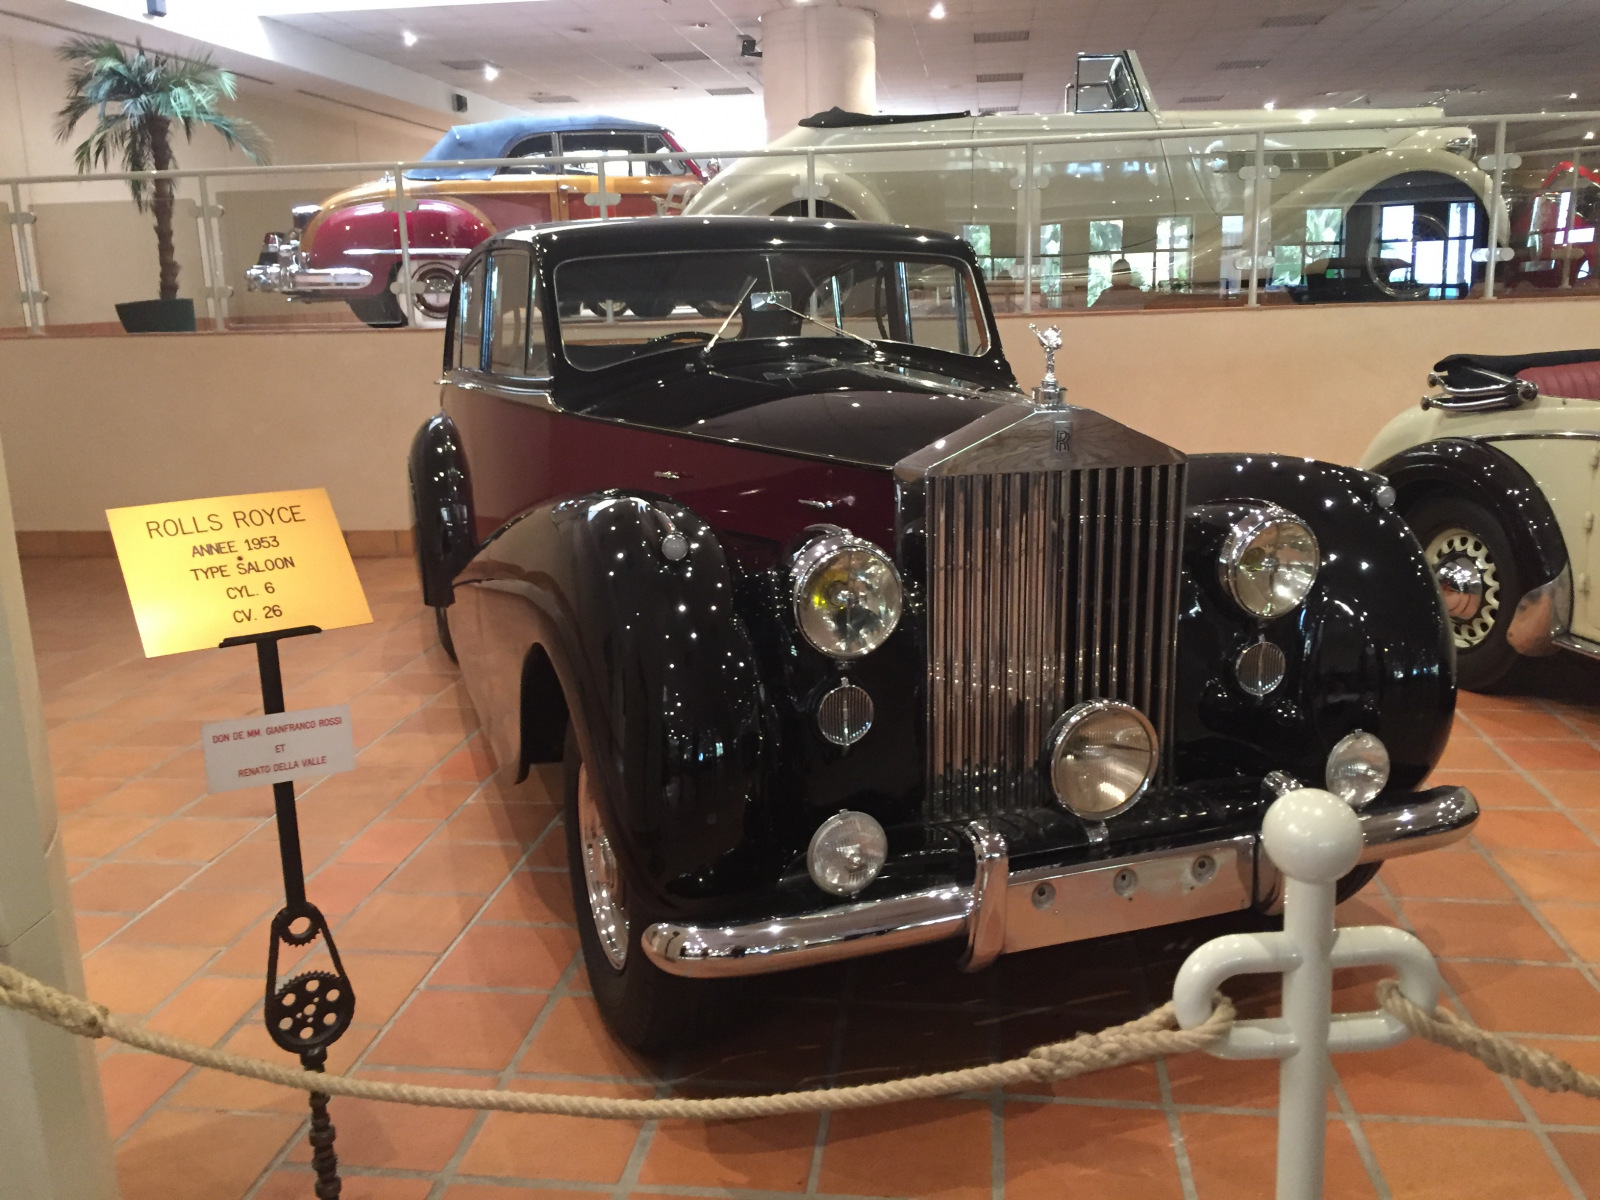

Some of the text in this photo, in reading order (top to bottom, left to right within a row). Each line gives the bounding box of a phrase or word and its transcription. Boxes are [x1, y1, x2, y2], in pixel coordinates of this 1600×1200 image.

[145, 505, 306, 539] ROLLS ROYCE
[191, 535, 280, 557] ANNEE 1953
[190, 556, 295, 581] TYPE SALOON
[226, 581, 275, 600] CYL. 6
[233, 604, 283, 623] CV. 26
[212, 733, 230, 744] DON
[233, 731, 243, 740] DE
[265, 720, 316, 736] GIANFRANCO
[318, 716, 342, 727] ROSSI
[275, 744, 285, 753] ET
[238, 755, 327, 778] RENATO DELLA VALLE
